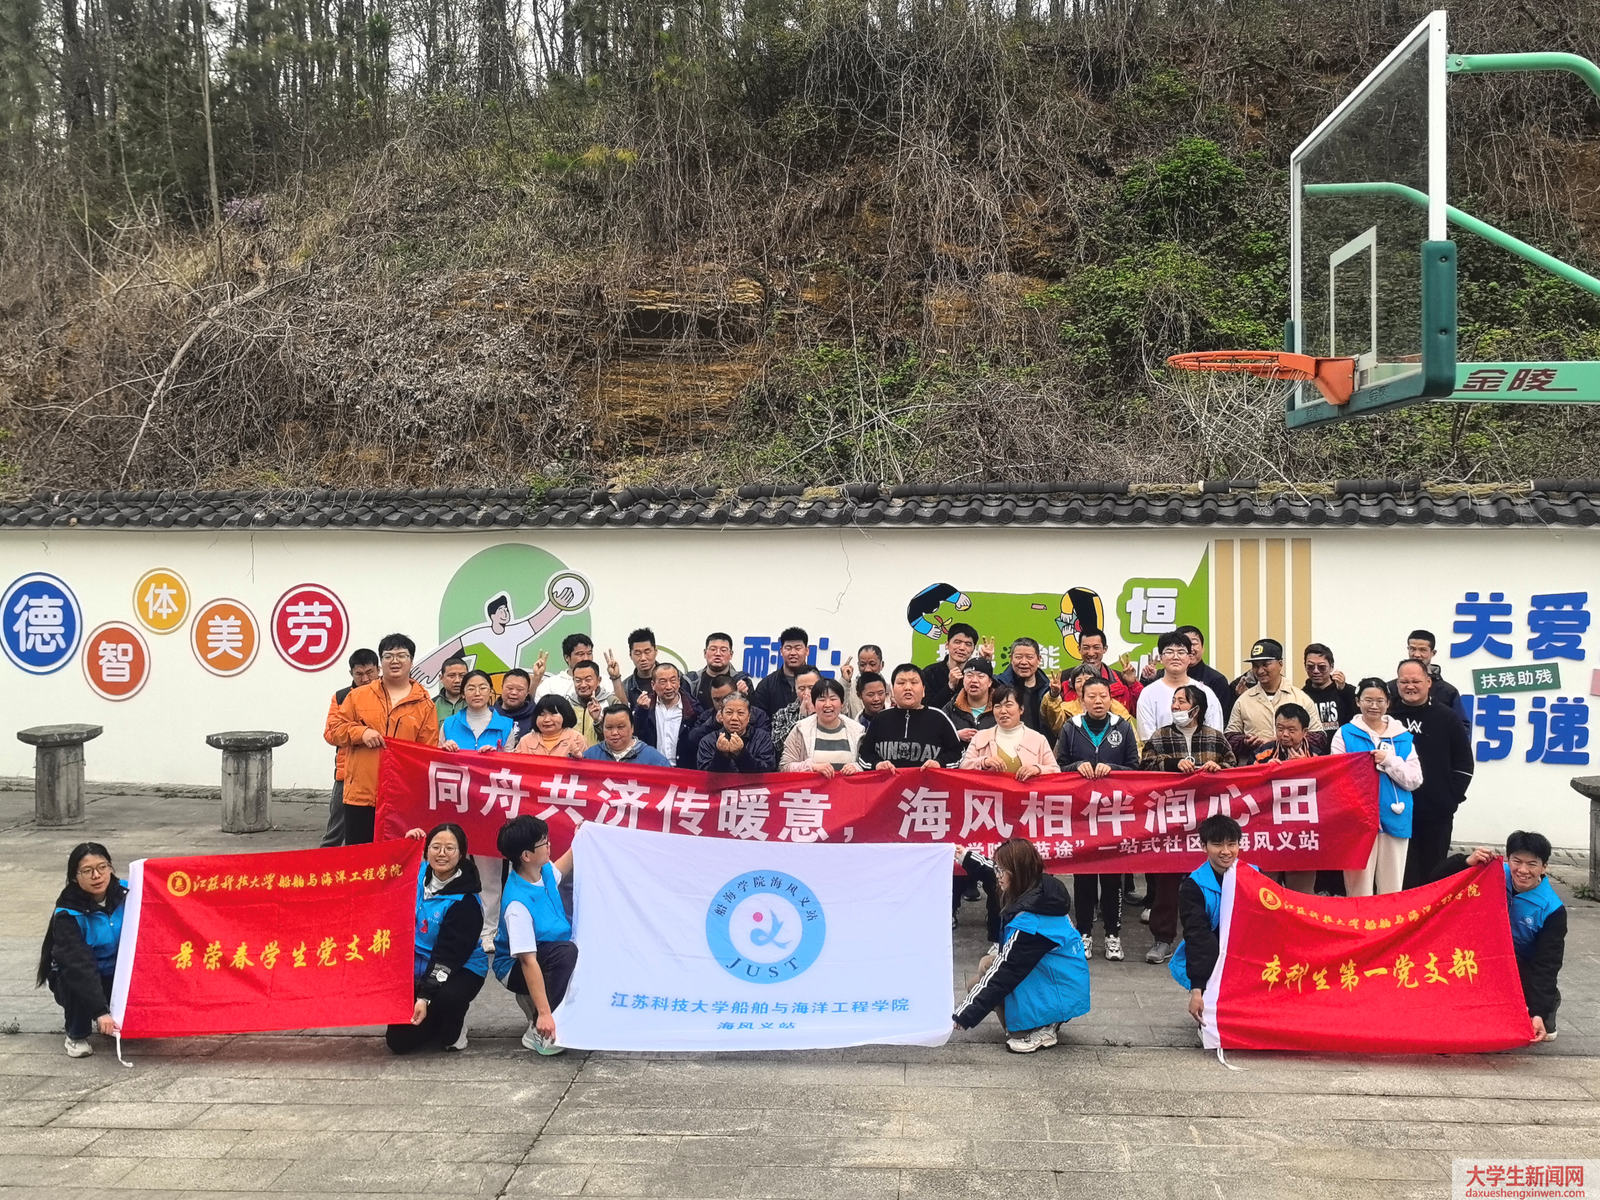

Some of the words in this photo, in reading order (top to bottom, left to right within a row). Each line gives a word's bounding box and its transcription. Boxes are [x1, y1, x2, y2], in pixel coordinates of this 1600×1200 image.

[1461, 368, 1558, 392] 金陵
[144, 583, 179, 620] 体
[1126, 587, 1178, 634] 恒
[13, 594, 66, 653] 德
[206, 614, 244, 660] 美
[285, 601, 333, 655] 劳
[1450, 591, 1591, 661] 关爱
[98, 640, 134, 683] 智
[1481, 668, 1553, 689] 扶残助残
[171, 928, 392, 971] 景荣春学生党支部
[725, 957, 799, 978] JUST
[1260, 947, 1478, 994] 本科生第一党支部
[610, 991, 910, 1015] 江苏科技大学船舶与海洋工程学院
